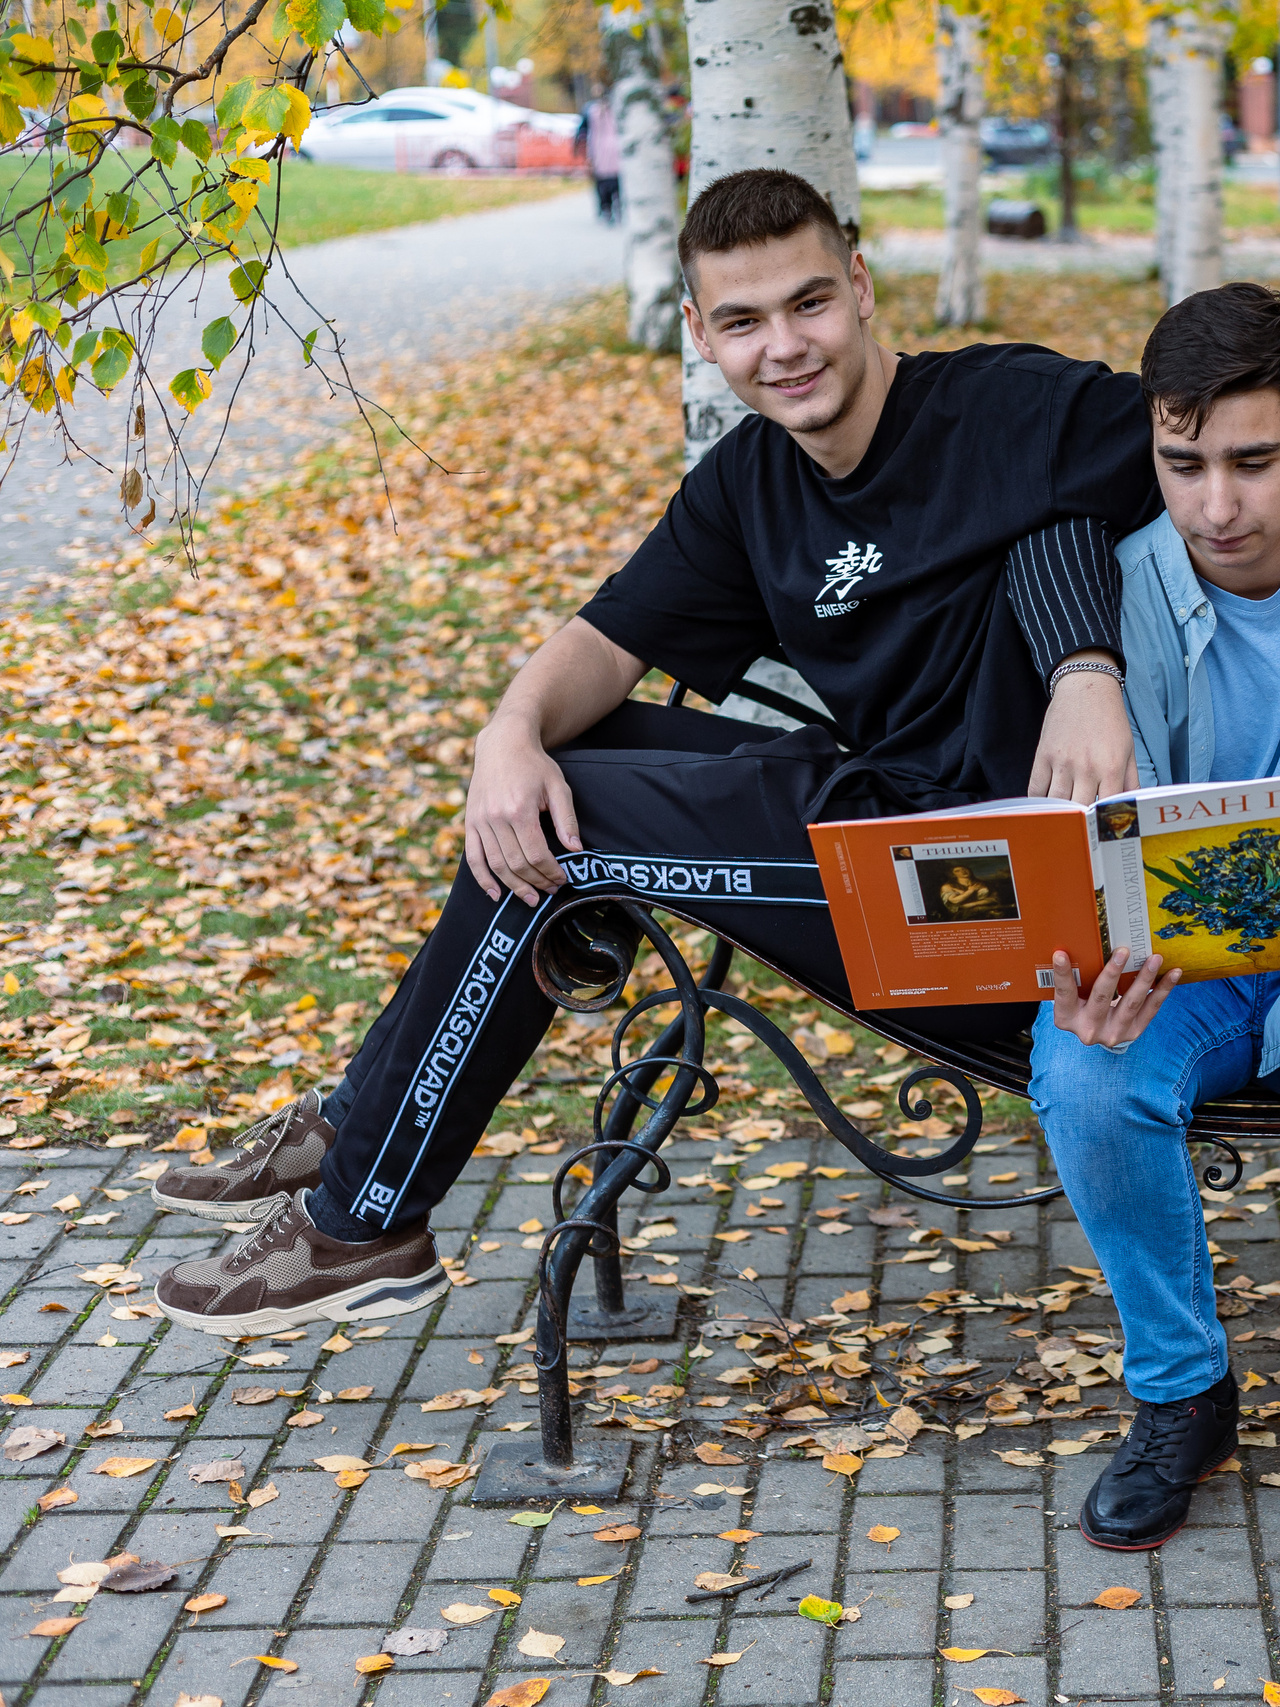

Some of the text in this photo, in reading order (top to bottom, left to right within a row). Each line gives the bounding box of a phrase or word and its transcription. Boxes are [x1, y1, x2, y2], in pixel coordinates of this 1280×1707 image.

[813, 599, 867, 618] ENERG
[1155, 793, 1250, 825] ВАН
[922, 844, 998, 856] ТИЦИАН
[1120, 840, 1148, 970] ВЕЛИКИЕ ХУДОЖНИКИ
